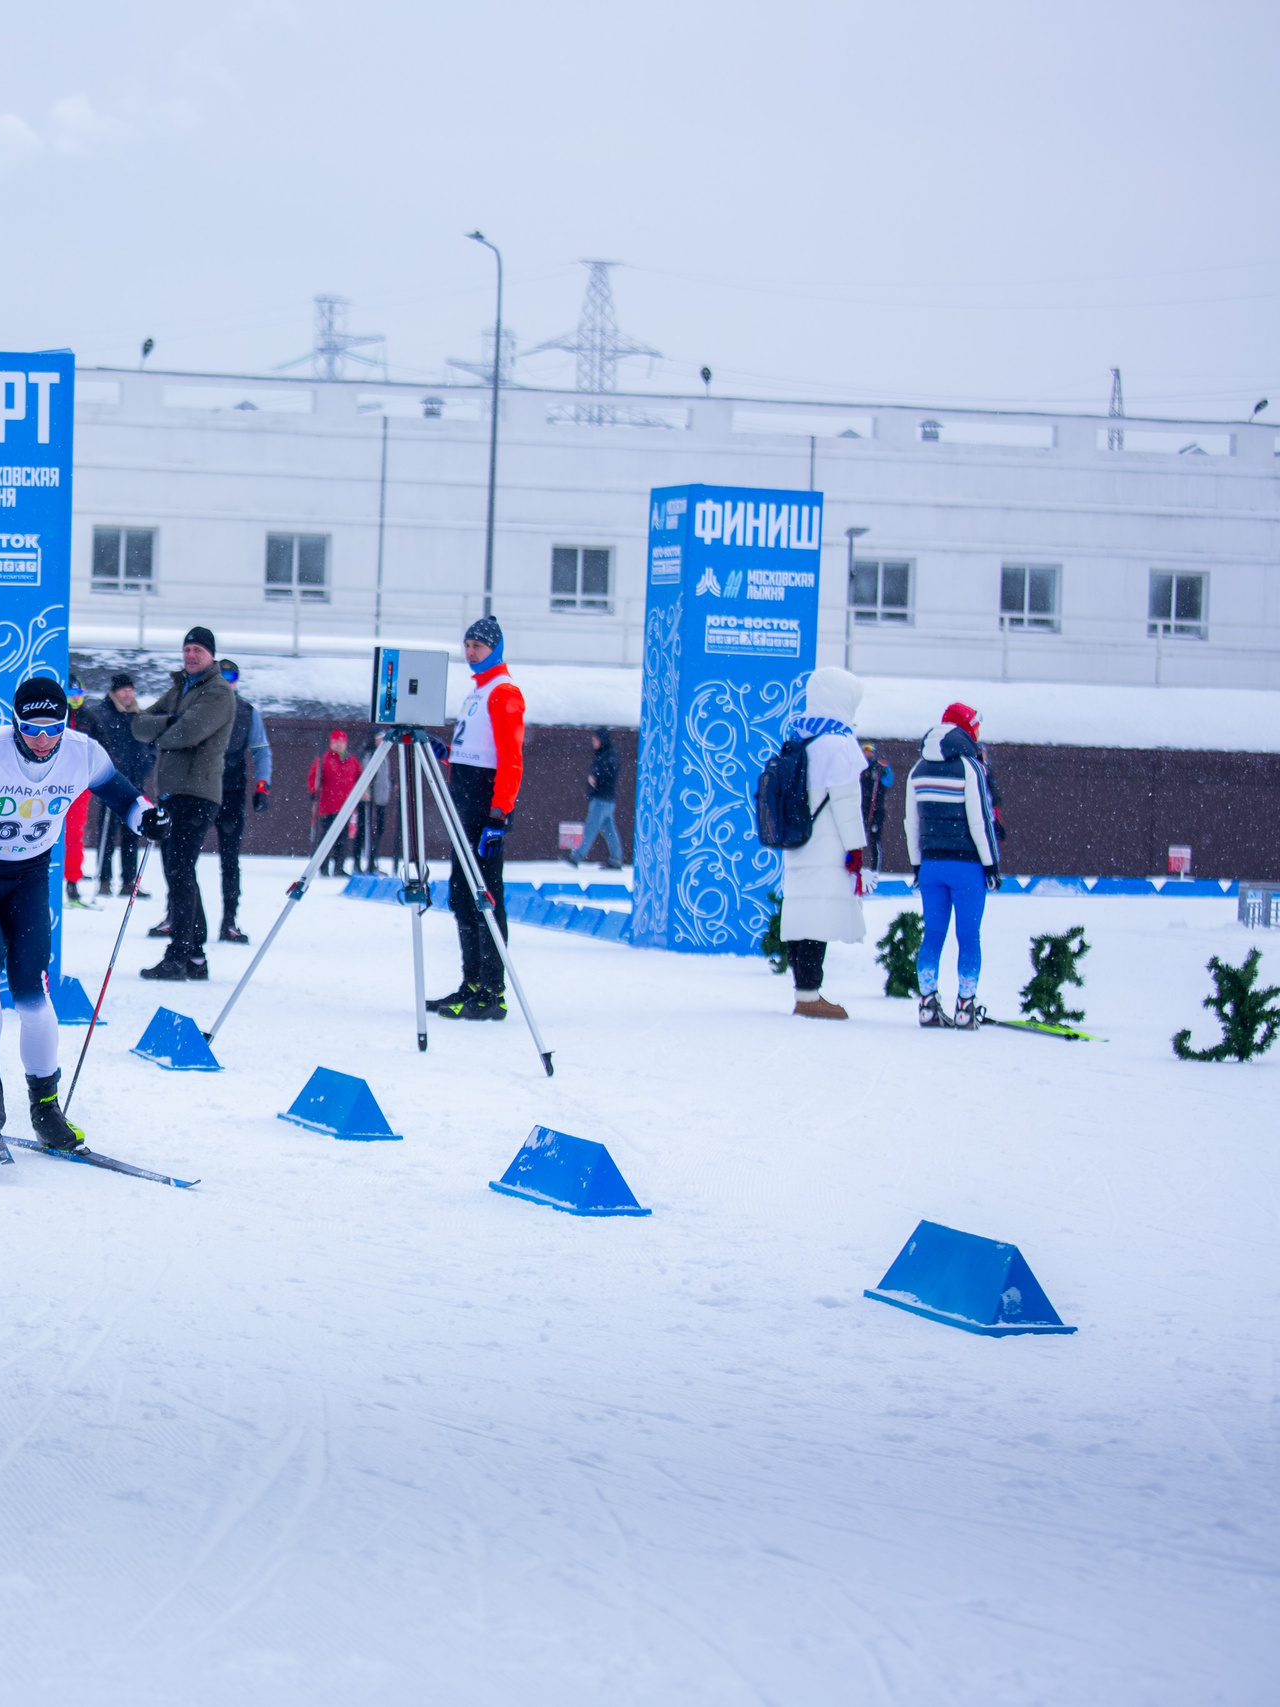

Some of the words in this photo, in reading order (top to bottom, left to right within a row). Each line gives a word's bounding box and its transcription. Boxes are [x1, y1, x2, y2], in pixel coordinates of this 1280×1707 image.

[694, 499, 821, 550] ФИНИШ
[746, 568, 815, 588] МОСКОВСКАЯ
[746, 585, 786, 601] ЛЫЖНЯ
[706, 614, 800, 631] ЮГО-ВОСТОК
